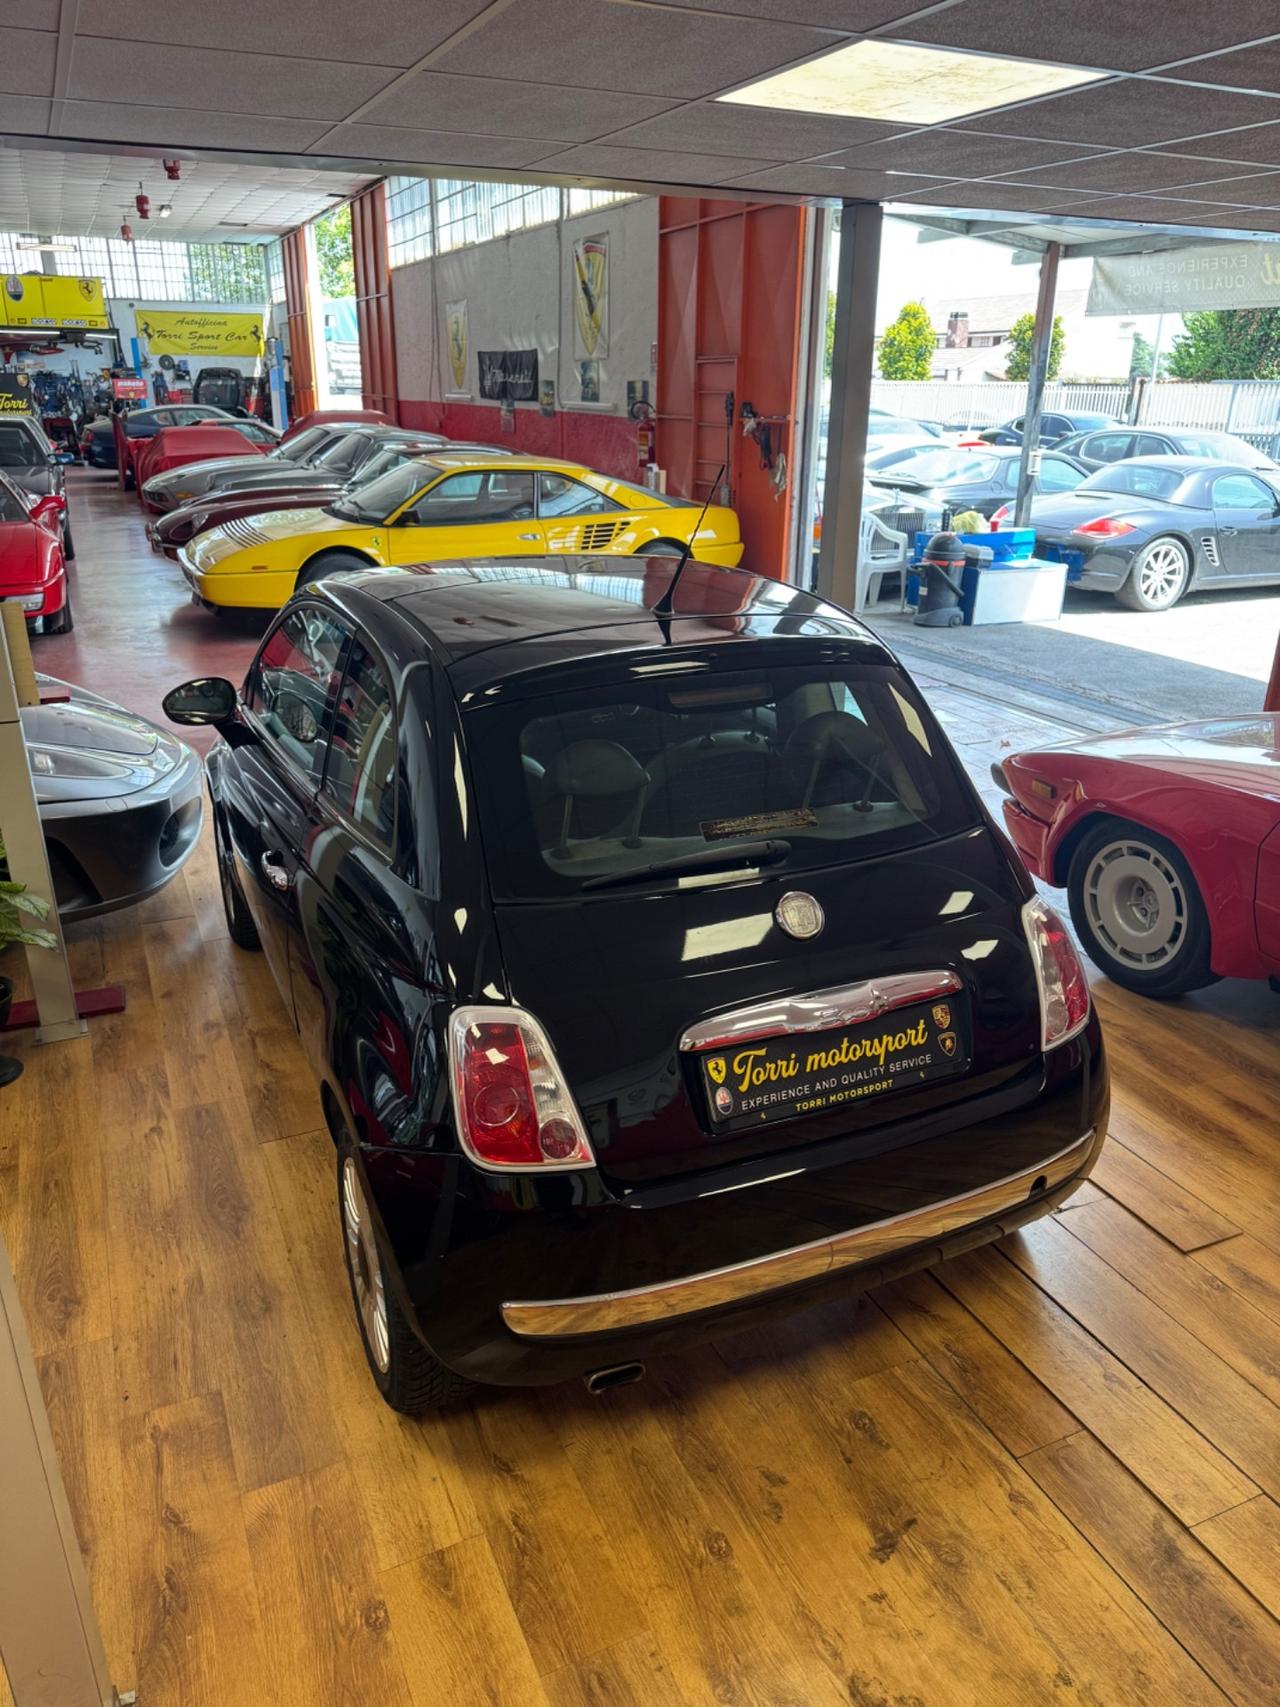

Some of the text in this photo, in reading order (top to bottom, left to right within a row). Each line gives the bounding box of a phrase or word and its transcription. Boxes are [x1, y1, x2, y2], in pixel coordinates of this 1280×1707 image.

[156, 329, 248, 342] Torri Sport Car
[175, 316, 228, 328] Autofficina
[732, 1019, 928, 1094] Torri motorsport
[741, 1054, 932, 1110] EXPERIENCE AND QUALITY SERVICE
[795, 1080, 894, 1112] TORRI MOTORSPORT
